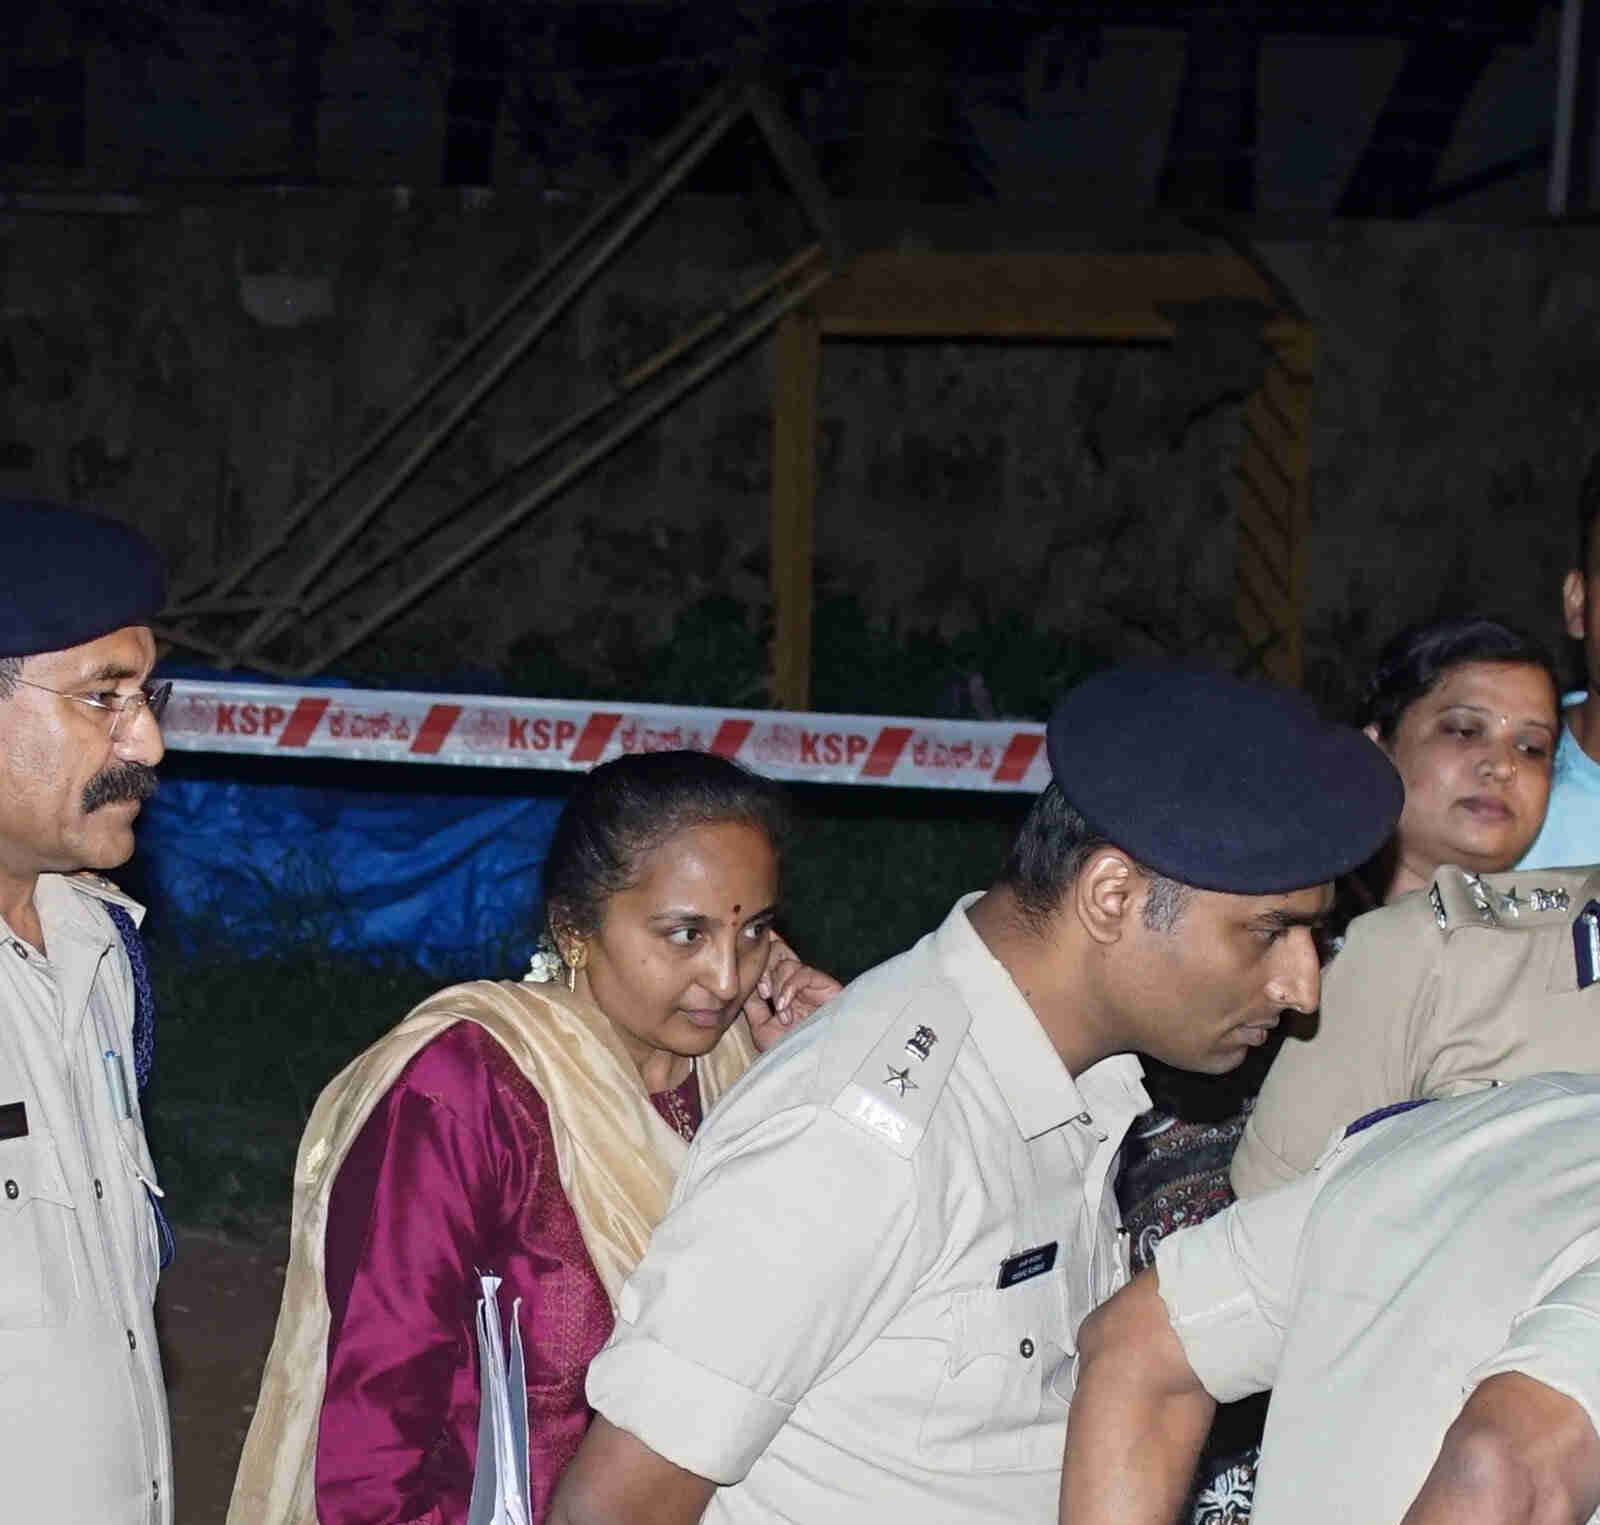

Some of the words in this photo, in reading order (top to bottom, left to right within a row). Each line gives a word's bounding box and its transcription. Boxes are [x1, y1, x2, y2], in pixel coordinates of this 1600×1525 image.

[216, 702, 285, 736] KSP
[508, 716, 577, 750] KSP
[801, 731, 869, 765] KSP
